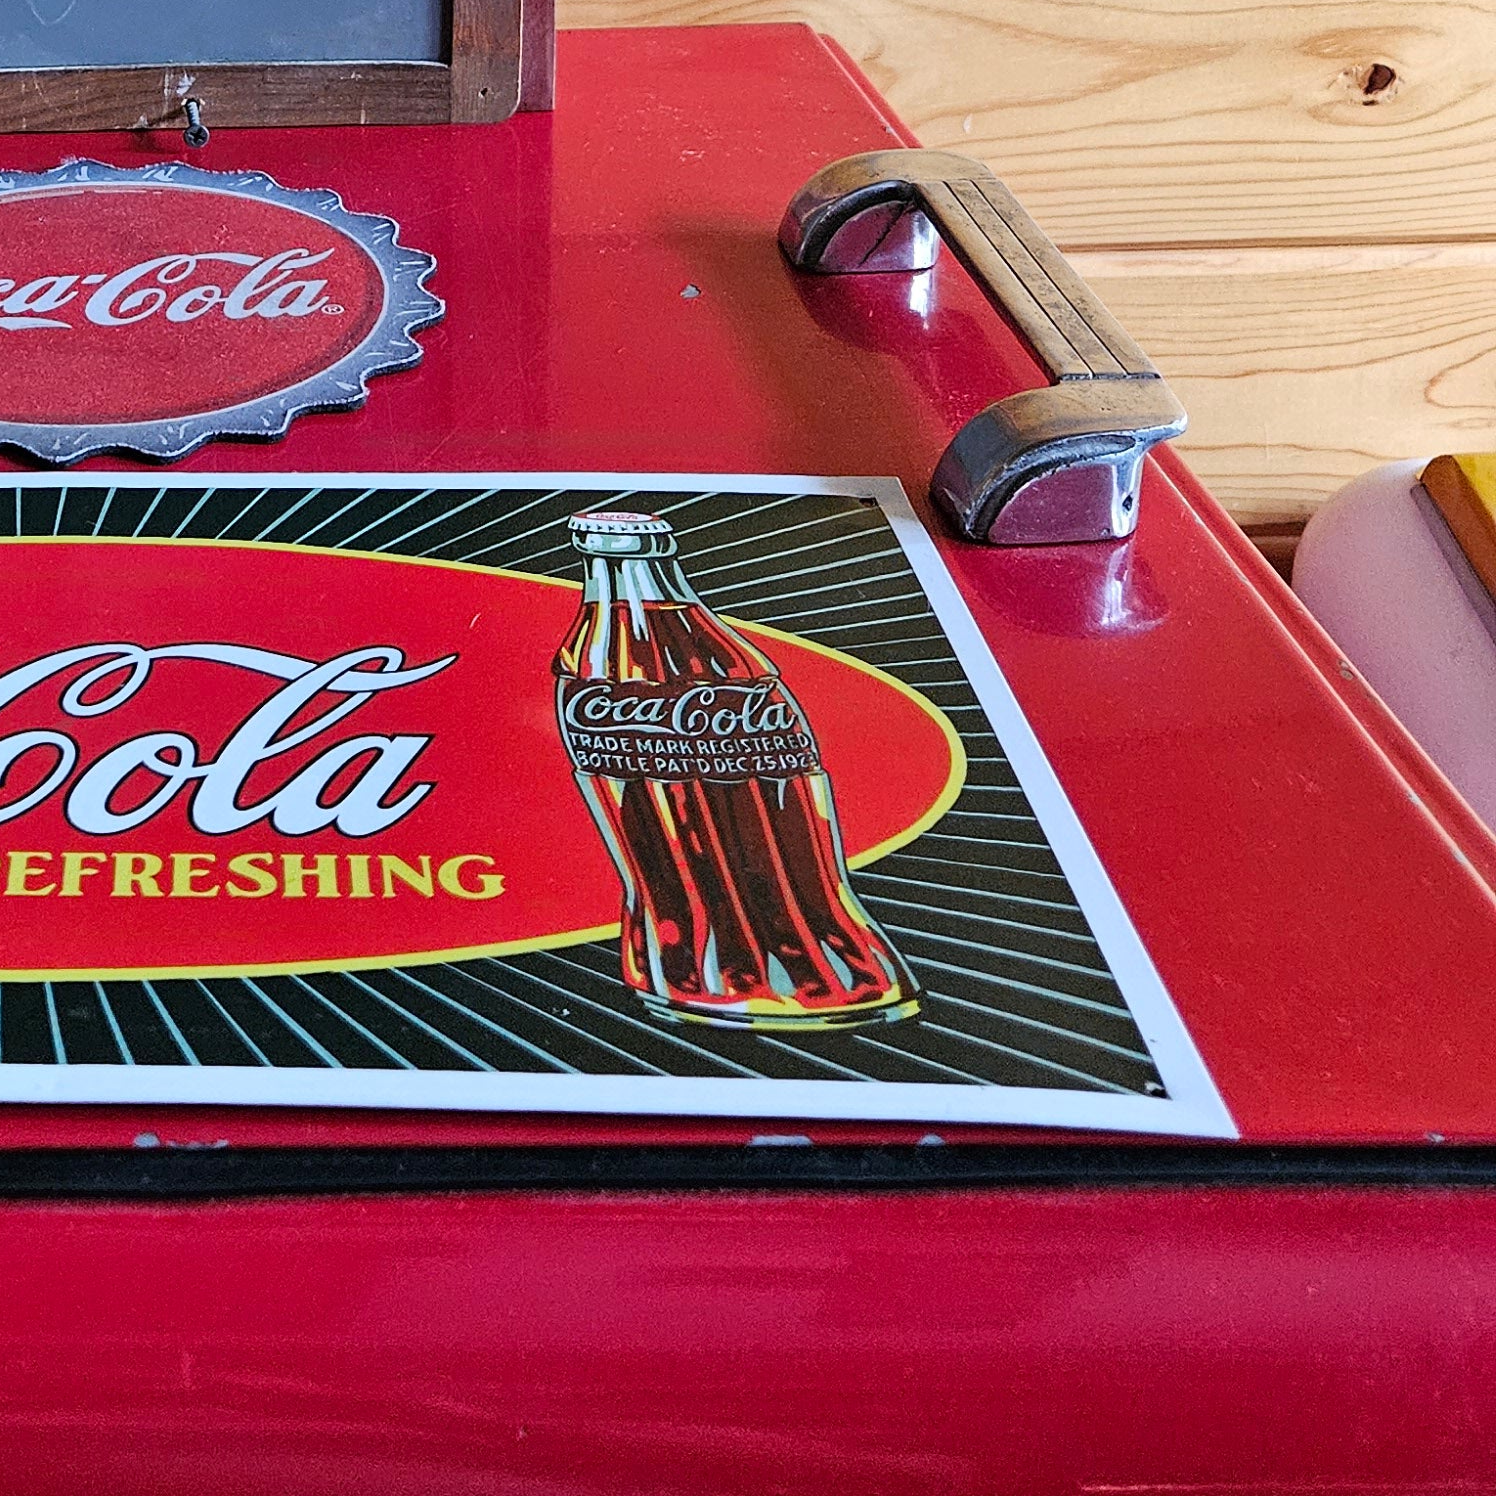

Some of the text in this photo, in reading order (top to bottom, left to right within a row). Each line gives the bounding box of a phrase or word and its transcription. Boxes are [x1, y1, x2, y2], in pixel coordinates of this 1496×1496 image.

[569, 731, 811, 755] TRADE MARK REGISTERED
[576, 750, 651, 773] BOTTLE
